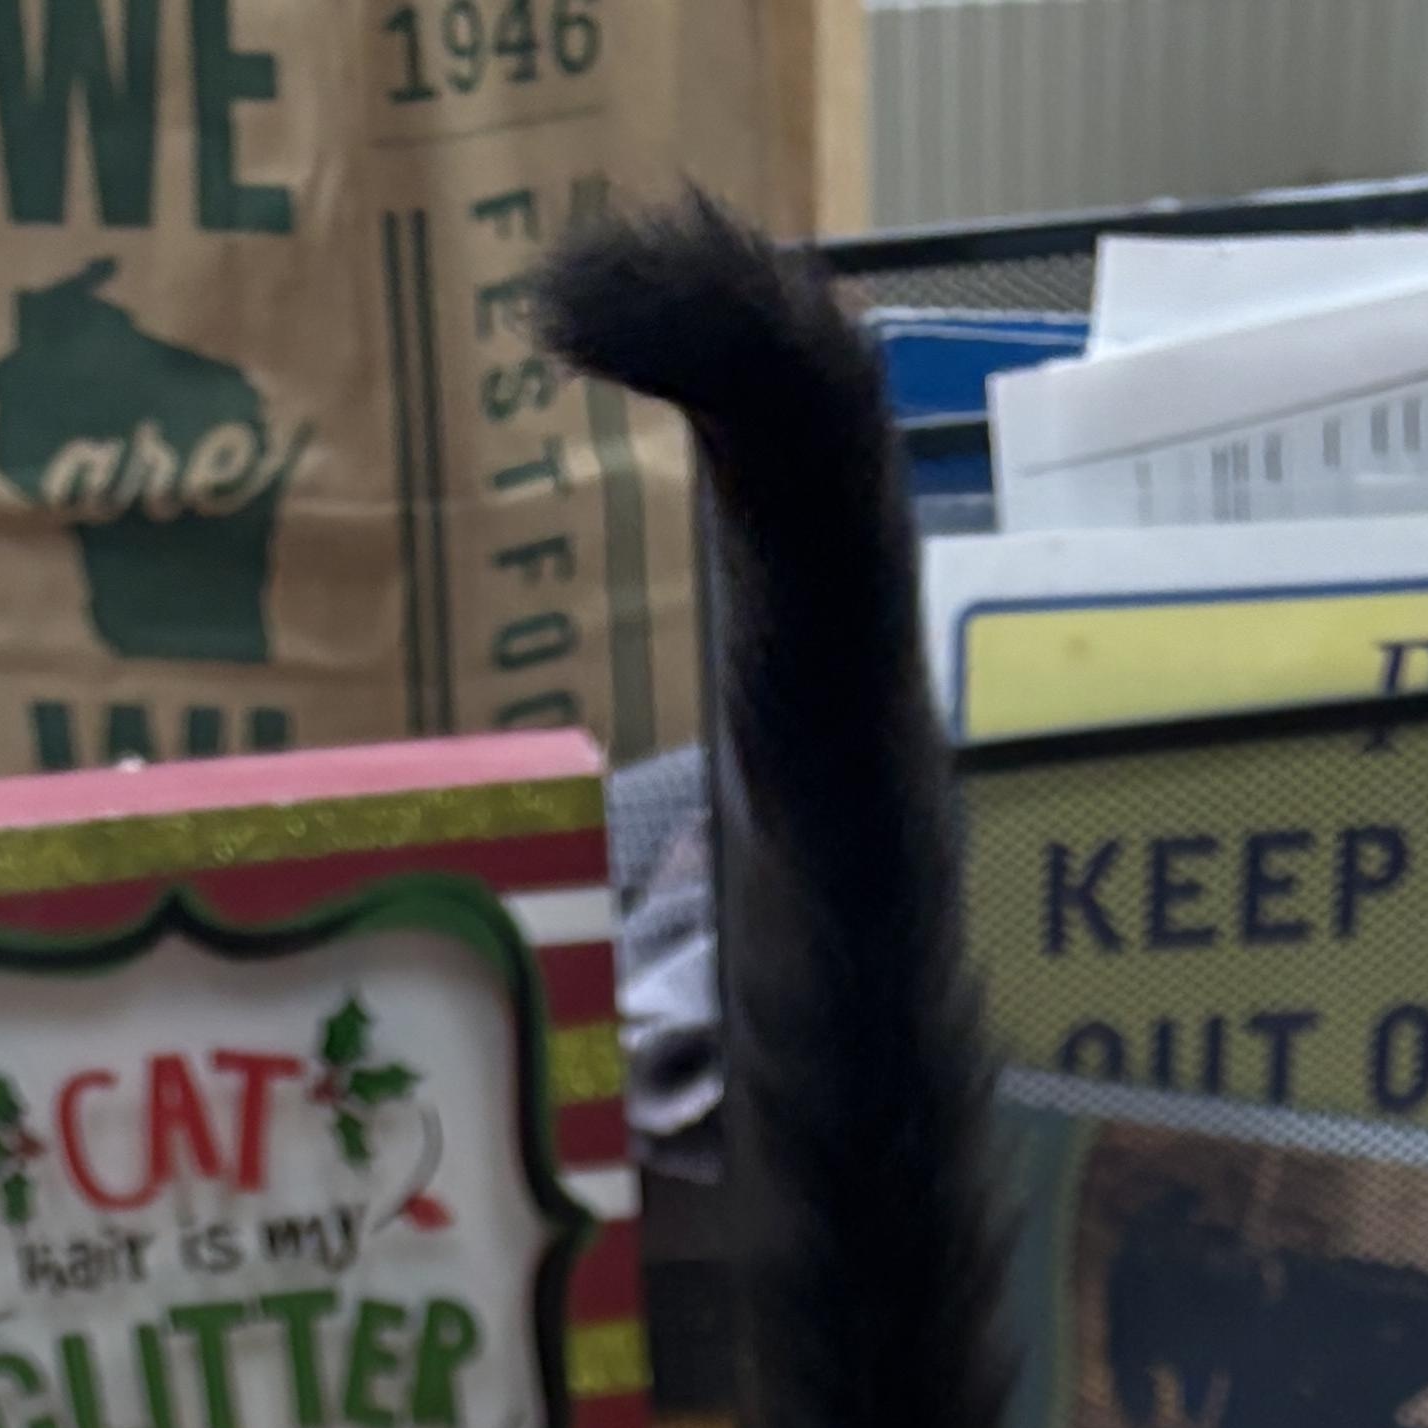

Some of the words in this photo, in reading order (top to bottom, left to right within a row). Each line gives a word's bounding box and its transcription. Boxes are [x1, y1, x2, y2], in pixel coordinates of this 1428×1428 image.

[383, 0, 604, 104] 1946
[39, 414, 290, 523] are
[1040, 823, 1414, 957] KEEP
[56, 1047, 305, 1213] CAT
[22, 1226, 150, 1290] hair
[178, 1207, 244, 1275] is
[264, 1204, 364, 1273] my
